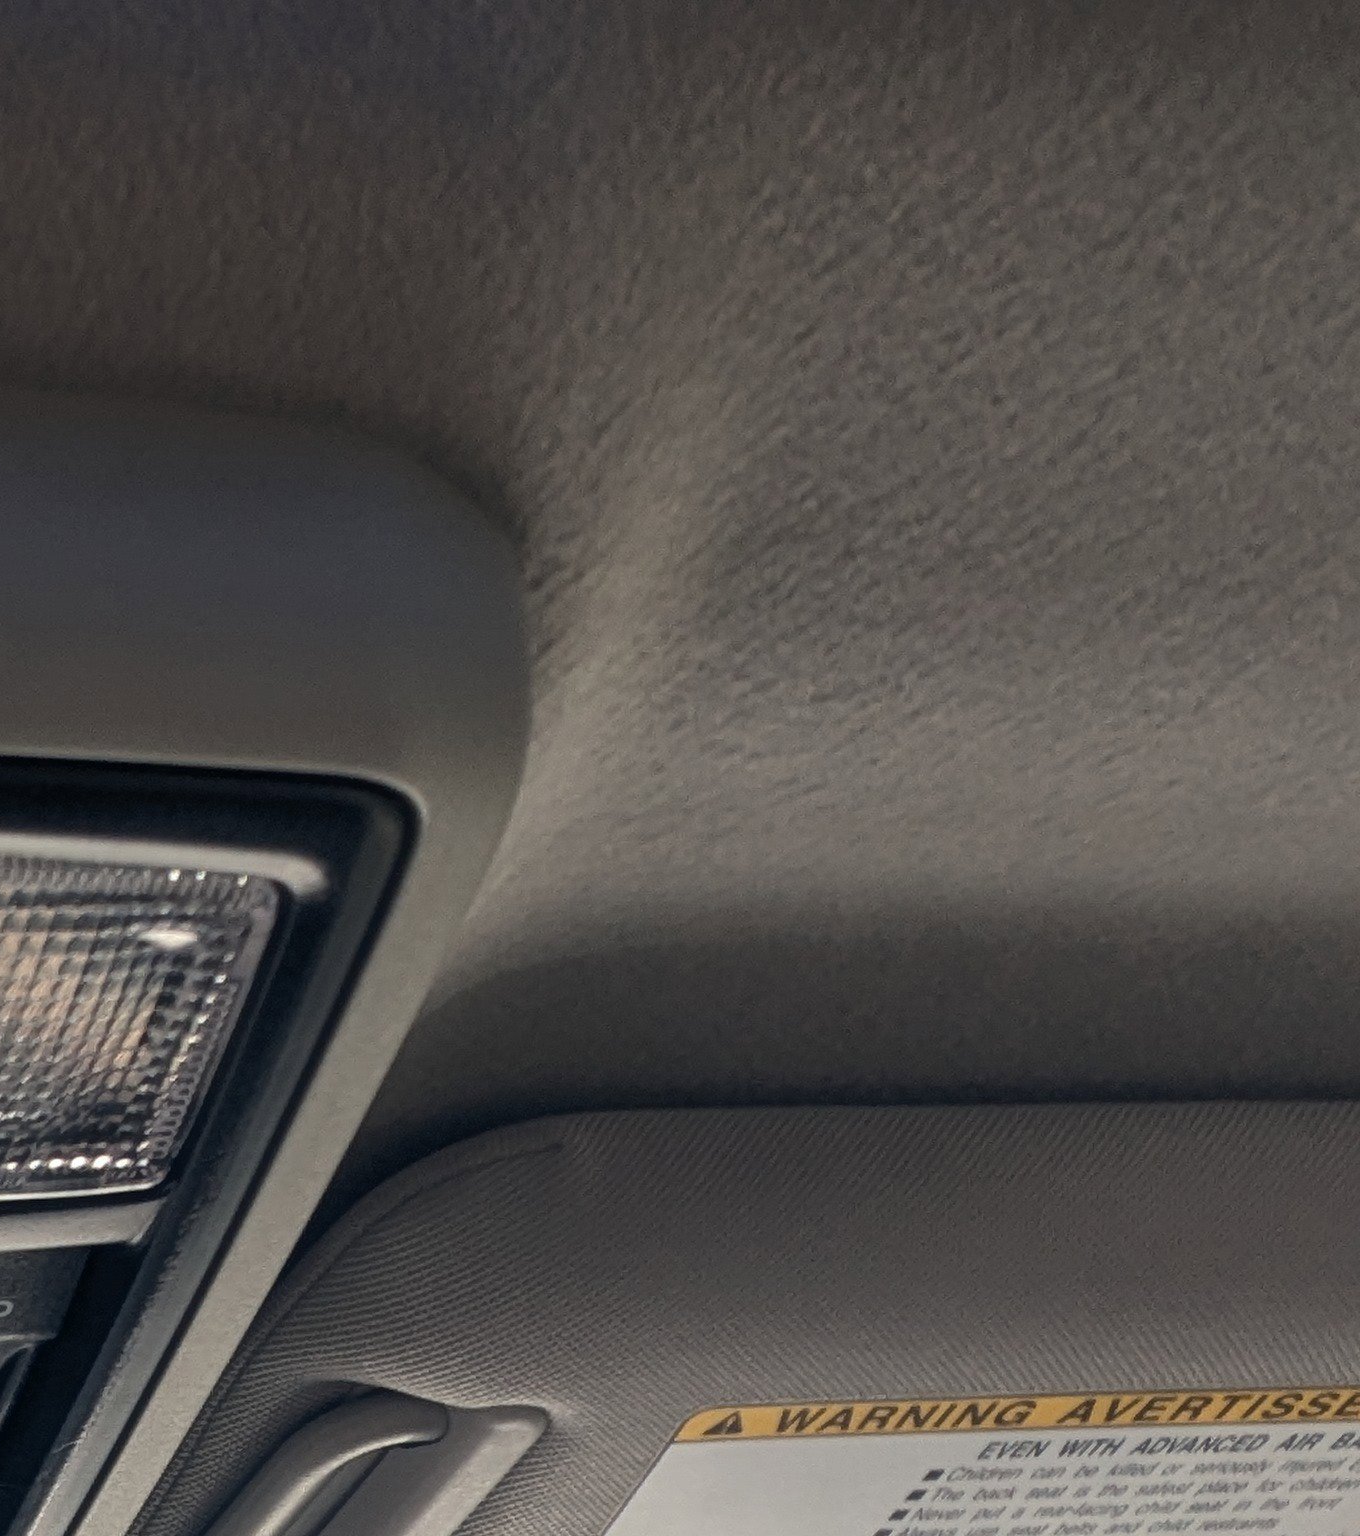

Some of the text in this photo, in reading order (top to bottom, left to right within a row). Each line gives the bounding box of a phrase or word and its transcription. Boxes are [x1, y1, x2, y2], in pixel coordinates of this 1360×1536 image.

[776, 1399, 1037, 1433] WARNING
[977, 1440, 1051, 1461] EVEN
[1058, 1437, 1126, 1459] WITH
[1130, 1434, 1271, 1456] ADVANCED
[1274, 1432, 1325, 1452] AIR
